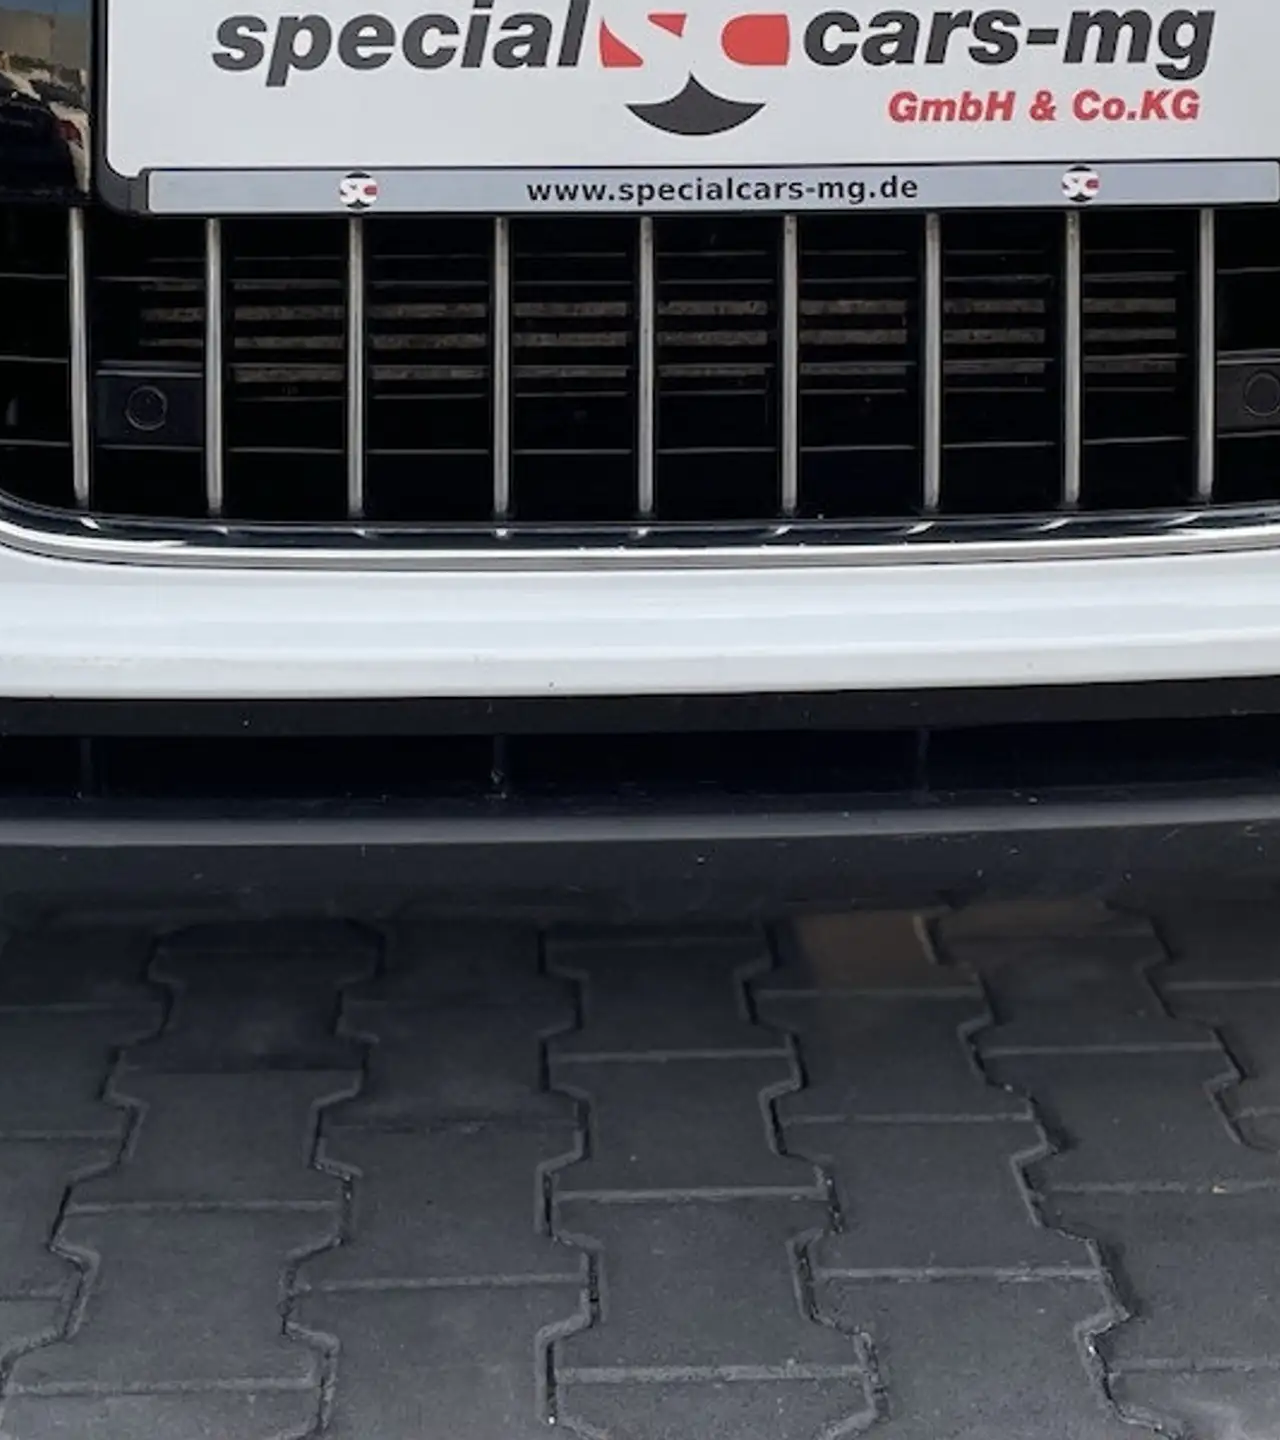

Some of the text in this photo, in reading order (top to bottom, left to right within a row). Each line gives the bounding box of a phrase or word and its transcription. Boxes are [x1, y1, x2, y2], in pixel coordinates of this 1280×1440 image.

[803, 9, 1216, 81] cars-mg
[887, 89, 1200, 122] GmbH & Co.KG
[526, 174, 918, 207] www.specialcars-mg.de
